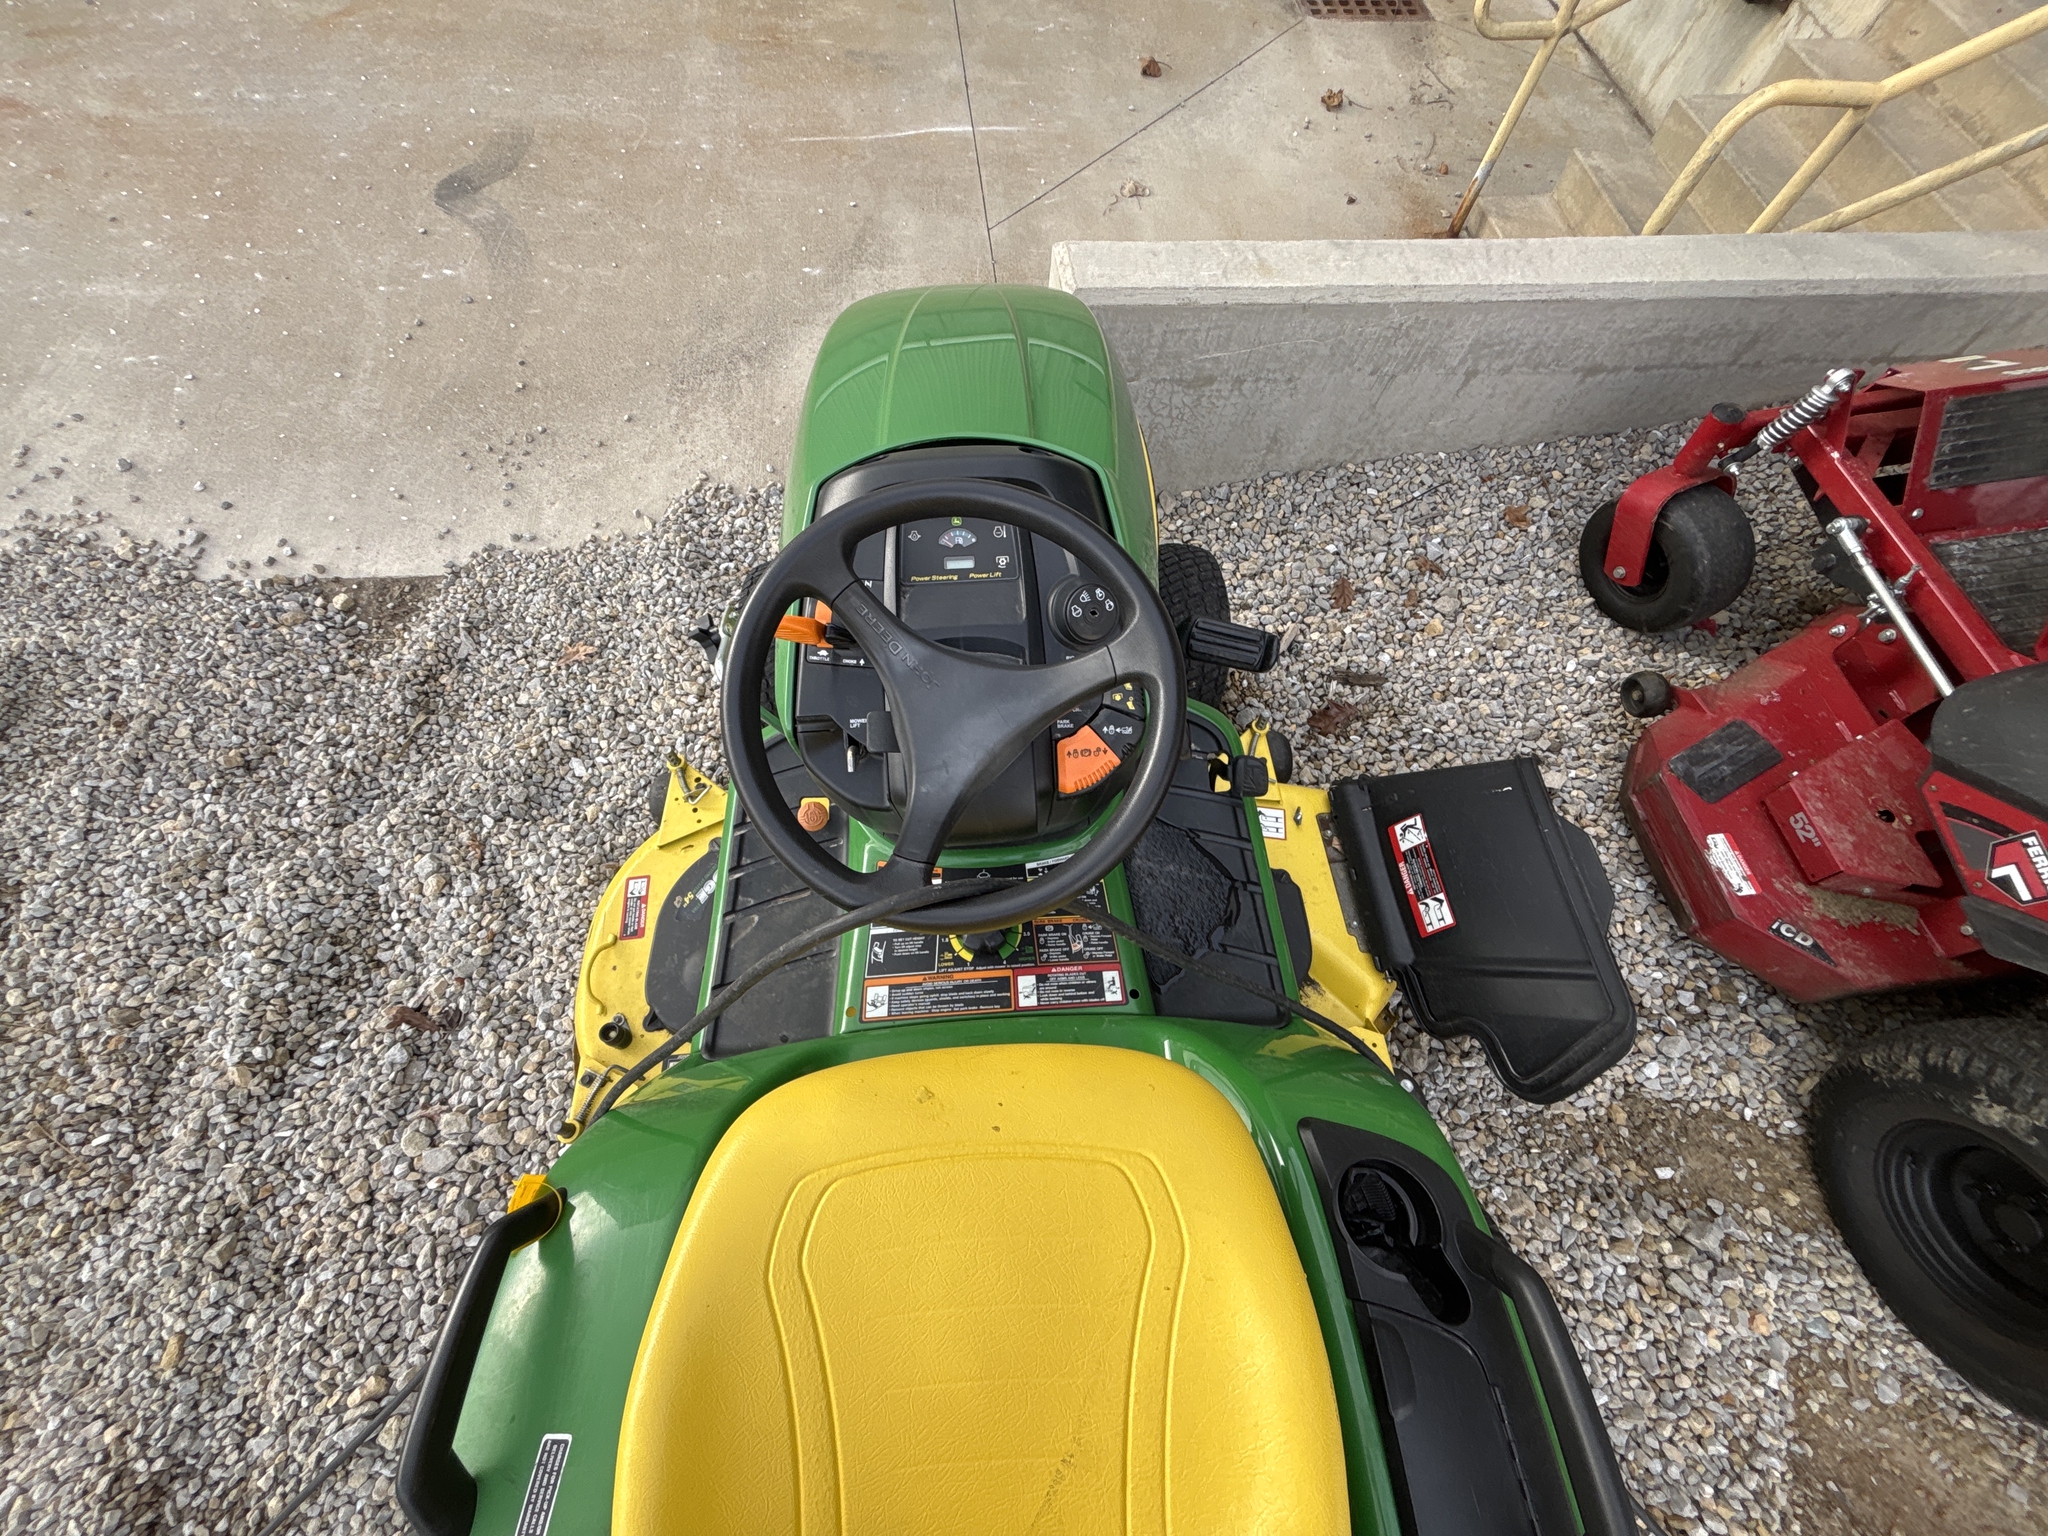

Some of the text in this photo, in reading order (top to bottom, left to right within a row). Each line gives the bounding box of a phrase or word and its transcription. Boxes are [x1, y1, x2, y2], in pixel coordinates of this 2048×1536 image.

[856, 603, 940, 691] JOHN DEERE
[1789, 812, 1822, 848] 52"
[1398, 862, 1412, 889] DANGER
